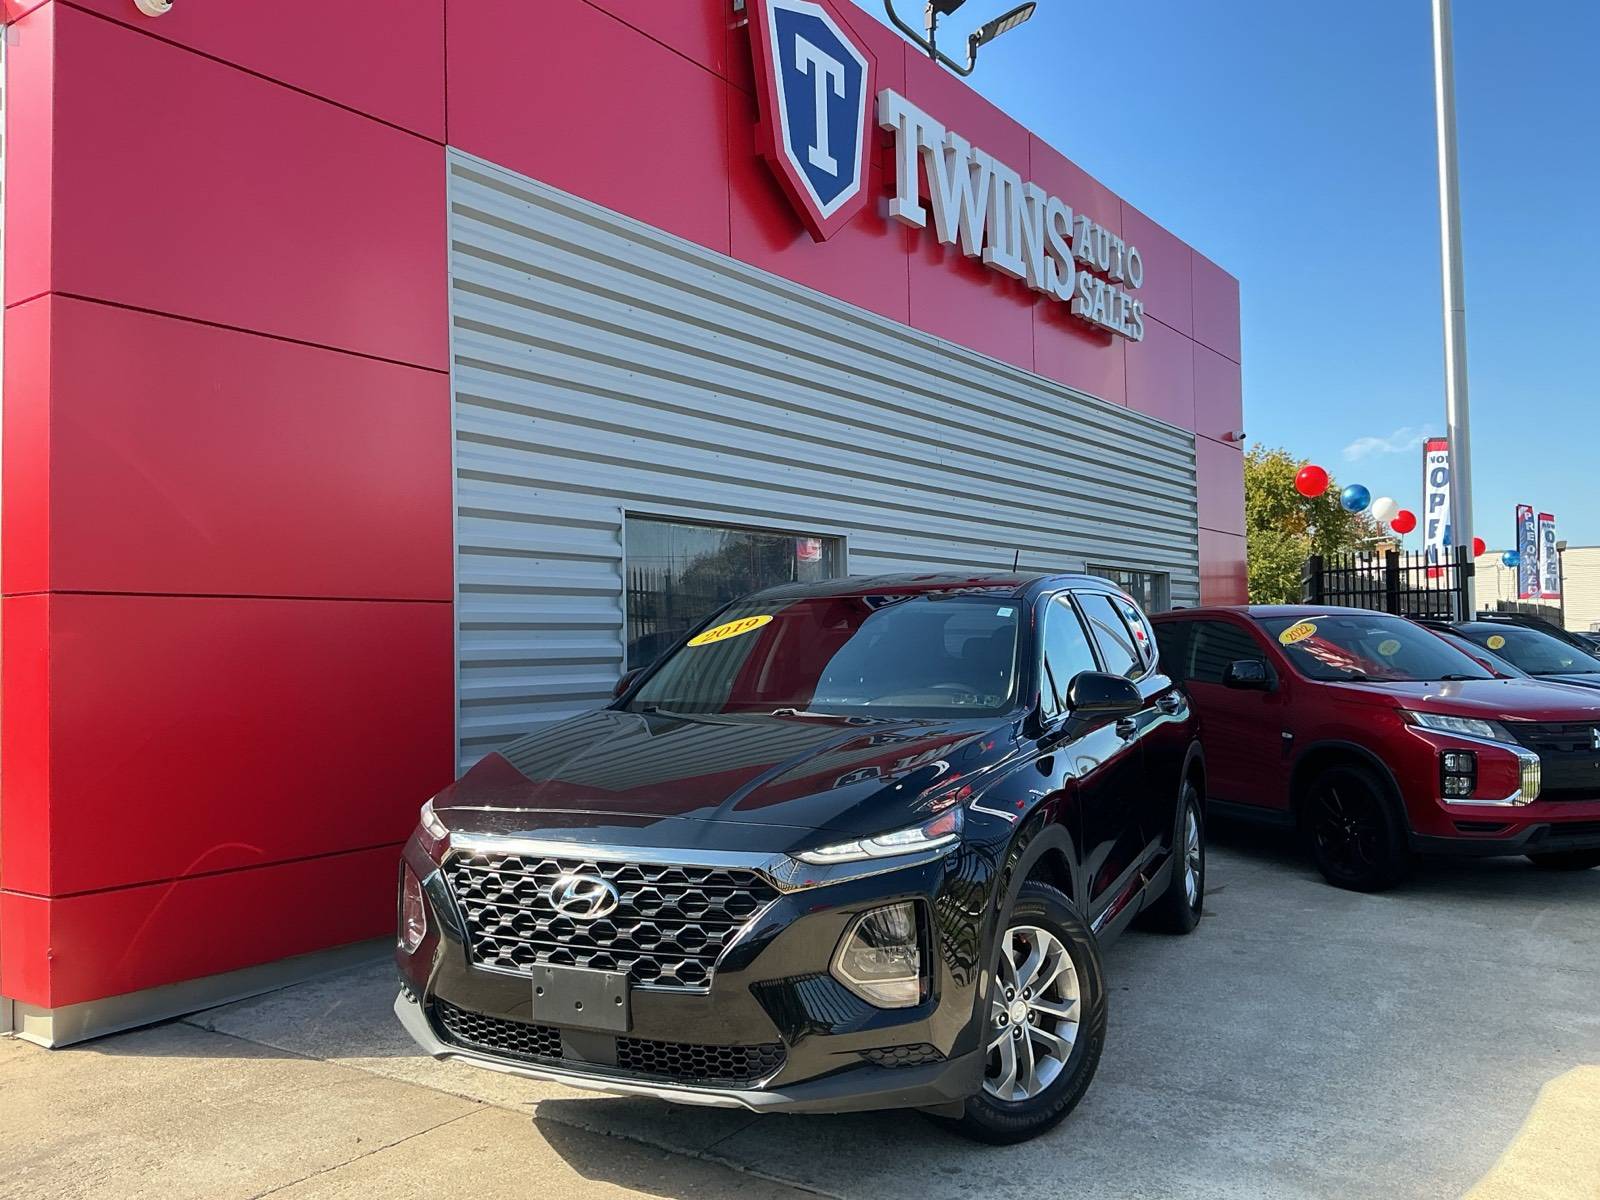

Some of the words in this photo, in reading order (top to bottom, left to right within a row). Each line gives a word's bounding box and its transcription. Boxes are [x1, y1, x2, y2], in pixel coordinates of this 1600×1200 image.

[795, 33, 845, 177] T
[878, 88, 1077, 301] TWINS
[1071, 214, 1144, 290] AUTO
[1071, 271, 1145, 343] SALES
[1427, 466, 1450, 564] OPEN
[1544, 530, 1557, 591] OPEN
[701, 618, 759, 643] 2019
[1285, 625, 1312, 641] 2022
